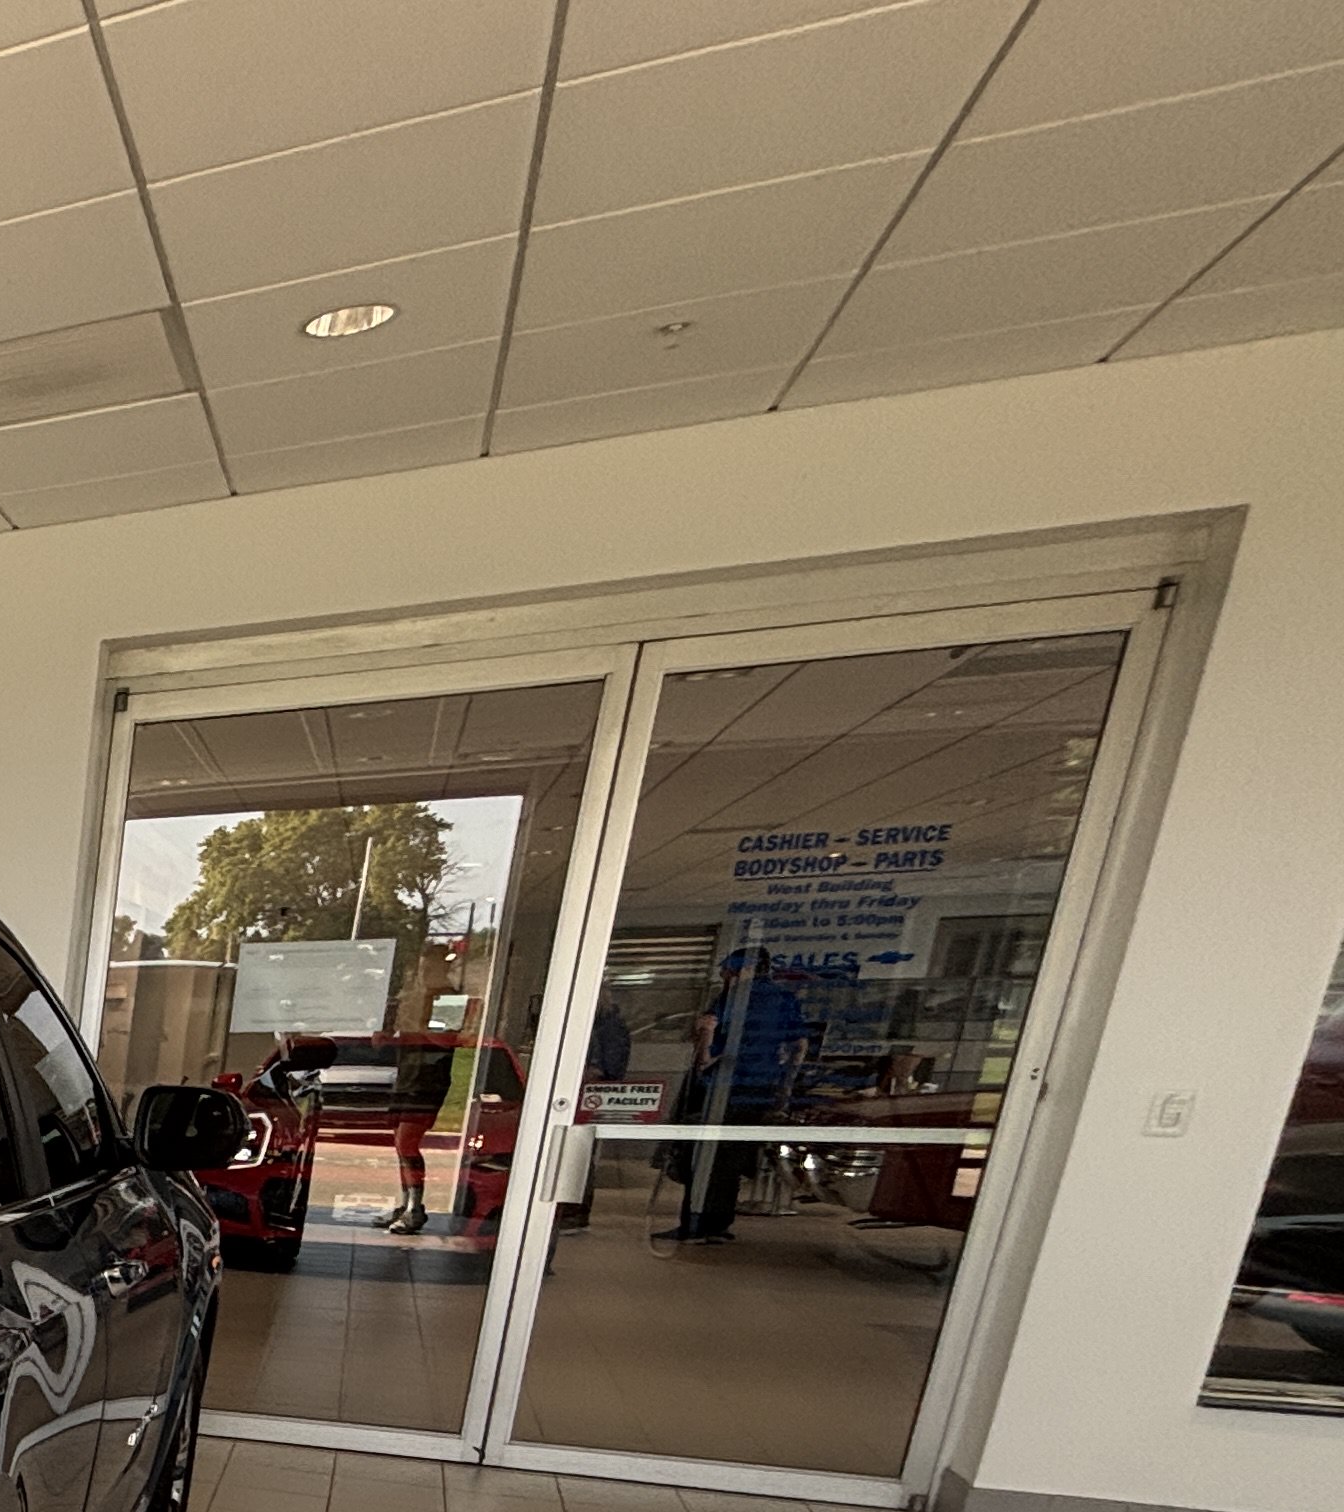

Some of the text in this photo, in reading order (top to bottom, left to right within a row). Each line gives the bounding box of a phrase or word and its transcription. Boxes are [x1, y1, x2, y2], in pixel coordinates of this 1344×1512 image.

[737, 832, 829, 852] CASHIER
[855, 824, 952, 846] SERVICE
[734, 854, 848, 877] BODYSHOP
[874, 850, 944, 869] PARTS
[767, 879, 895, 895] West Building
[727, 895, 922, 914] Monday thru Friday
[771, 951, 858, 970] SALES
[585, 1085, 660, 1094] SMOKE FREE
[607, 1097, 657, 1106] FACILITY
